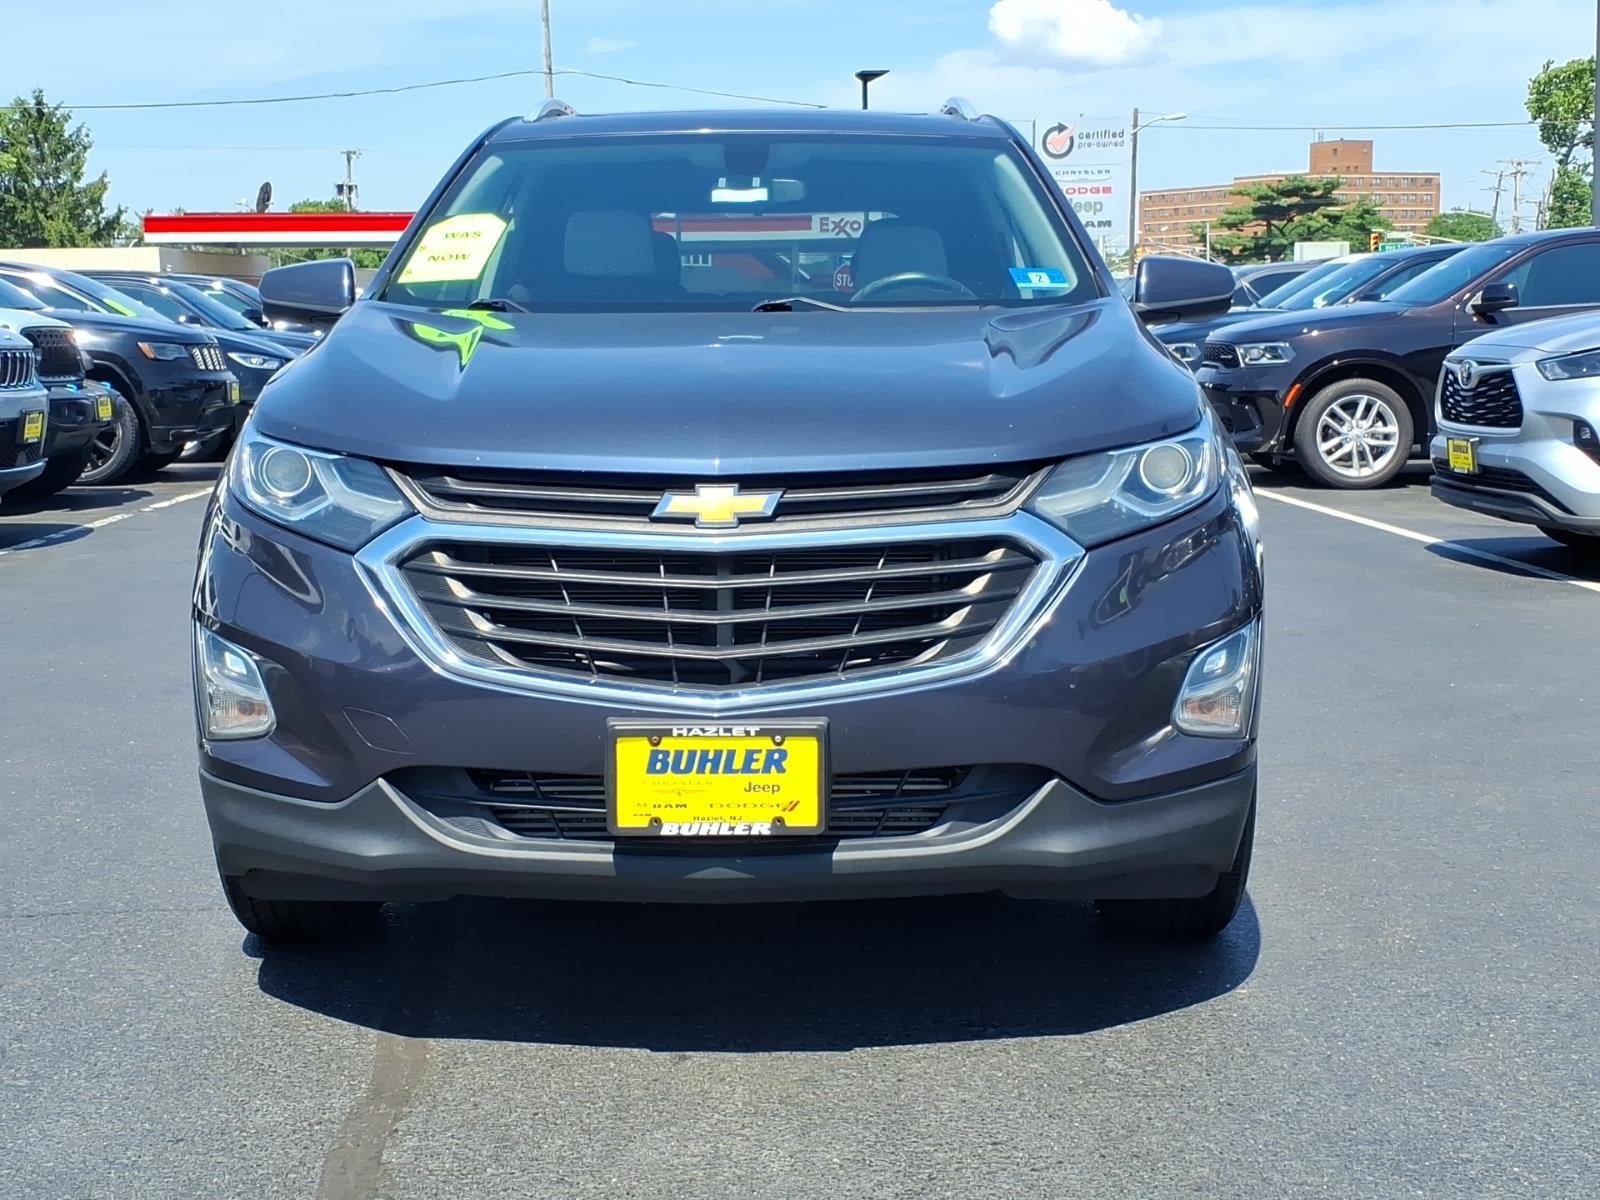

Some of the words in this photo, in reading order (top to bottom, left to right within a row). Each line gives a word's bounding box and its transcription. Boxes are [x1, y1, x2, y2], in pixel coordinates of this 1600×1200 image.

[1078, 129, 1125, 140] certified
[1078, 140, 1125, 149] pre-owned
[1065, 186, 1112, 195] ODGE
[1084, 220, 1112, 228] AM
[445, 231, 481, 239] WAS
[428, 254, 470, 262] NOW
[672, 727, 760, 737] HAZLET
[646, 748, 788, 775] BUHLER
[743, 781, 781, 794] Jeep
[660, 822, 772, 836] BUHLER
